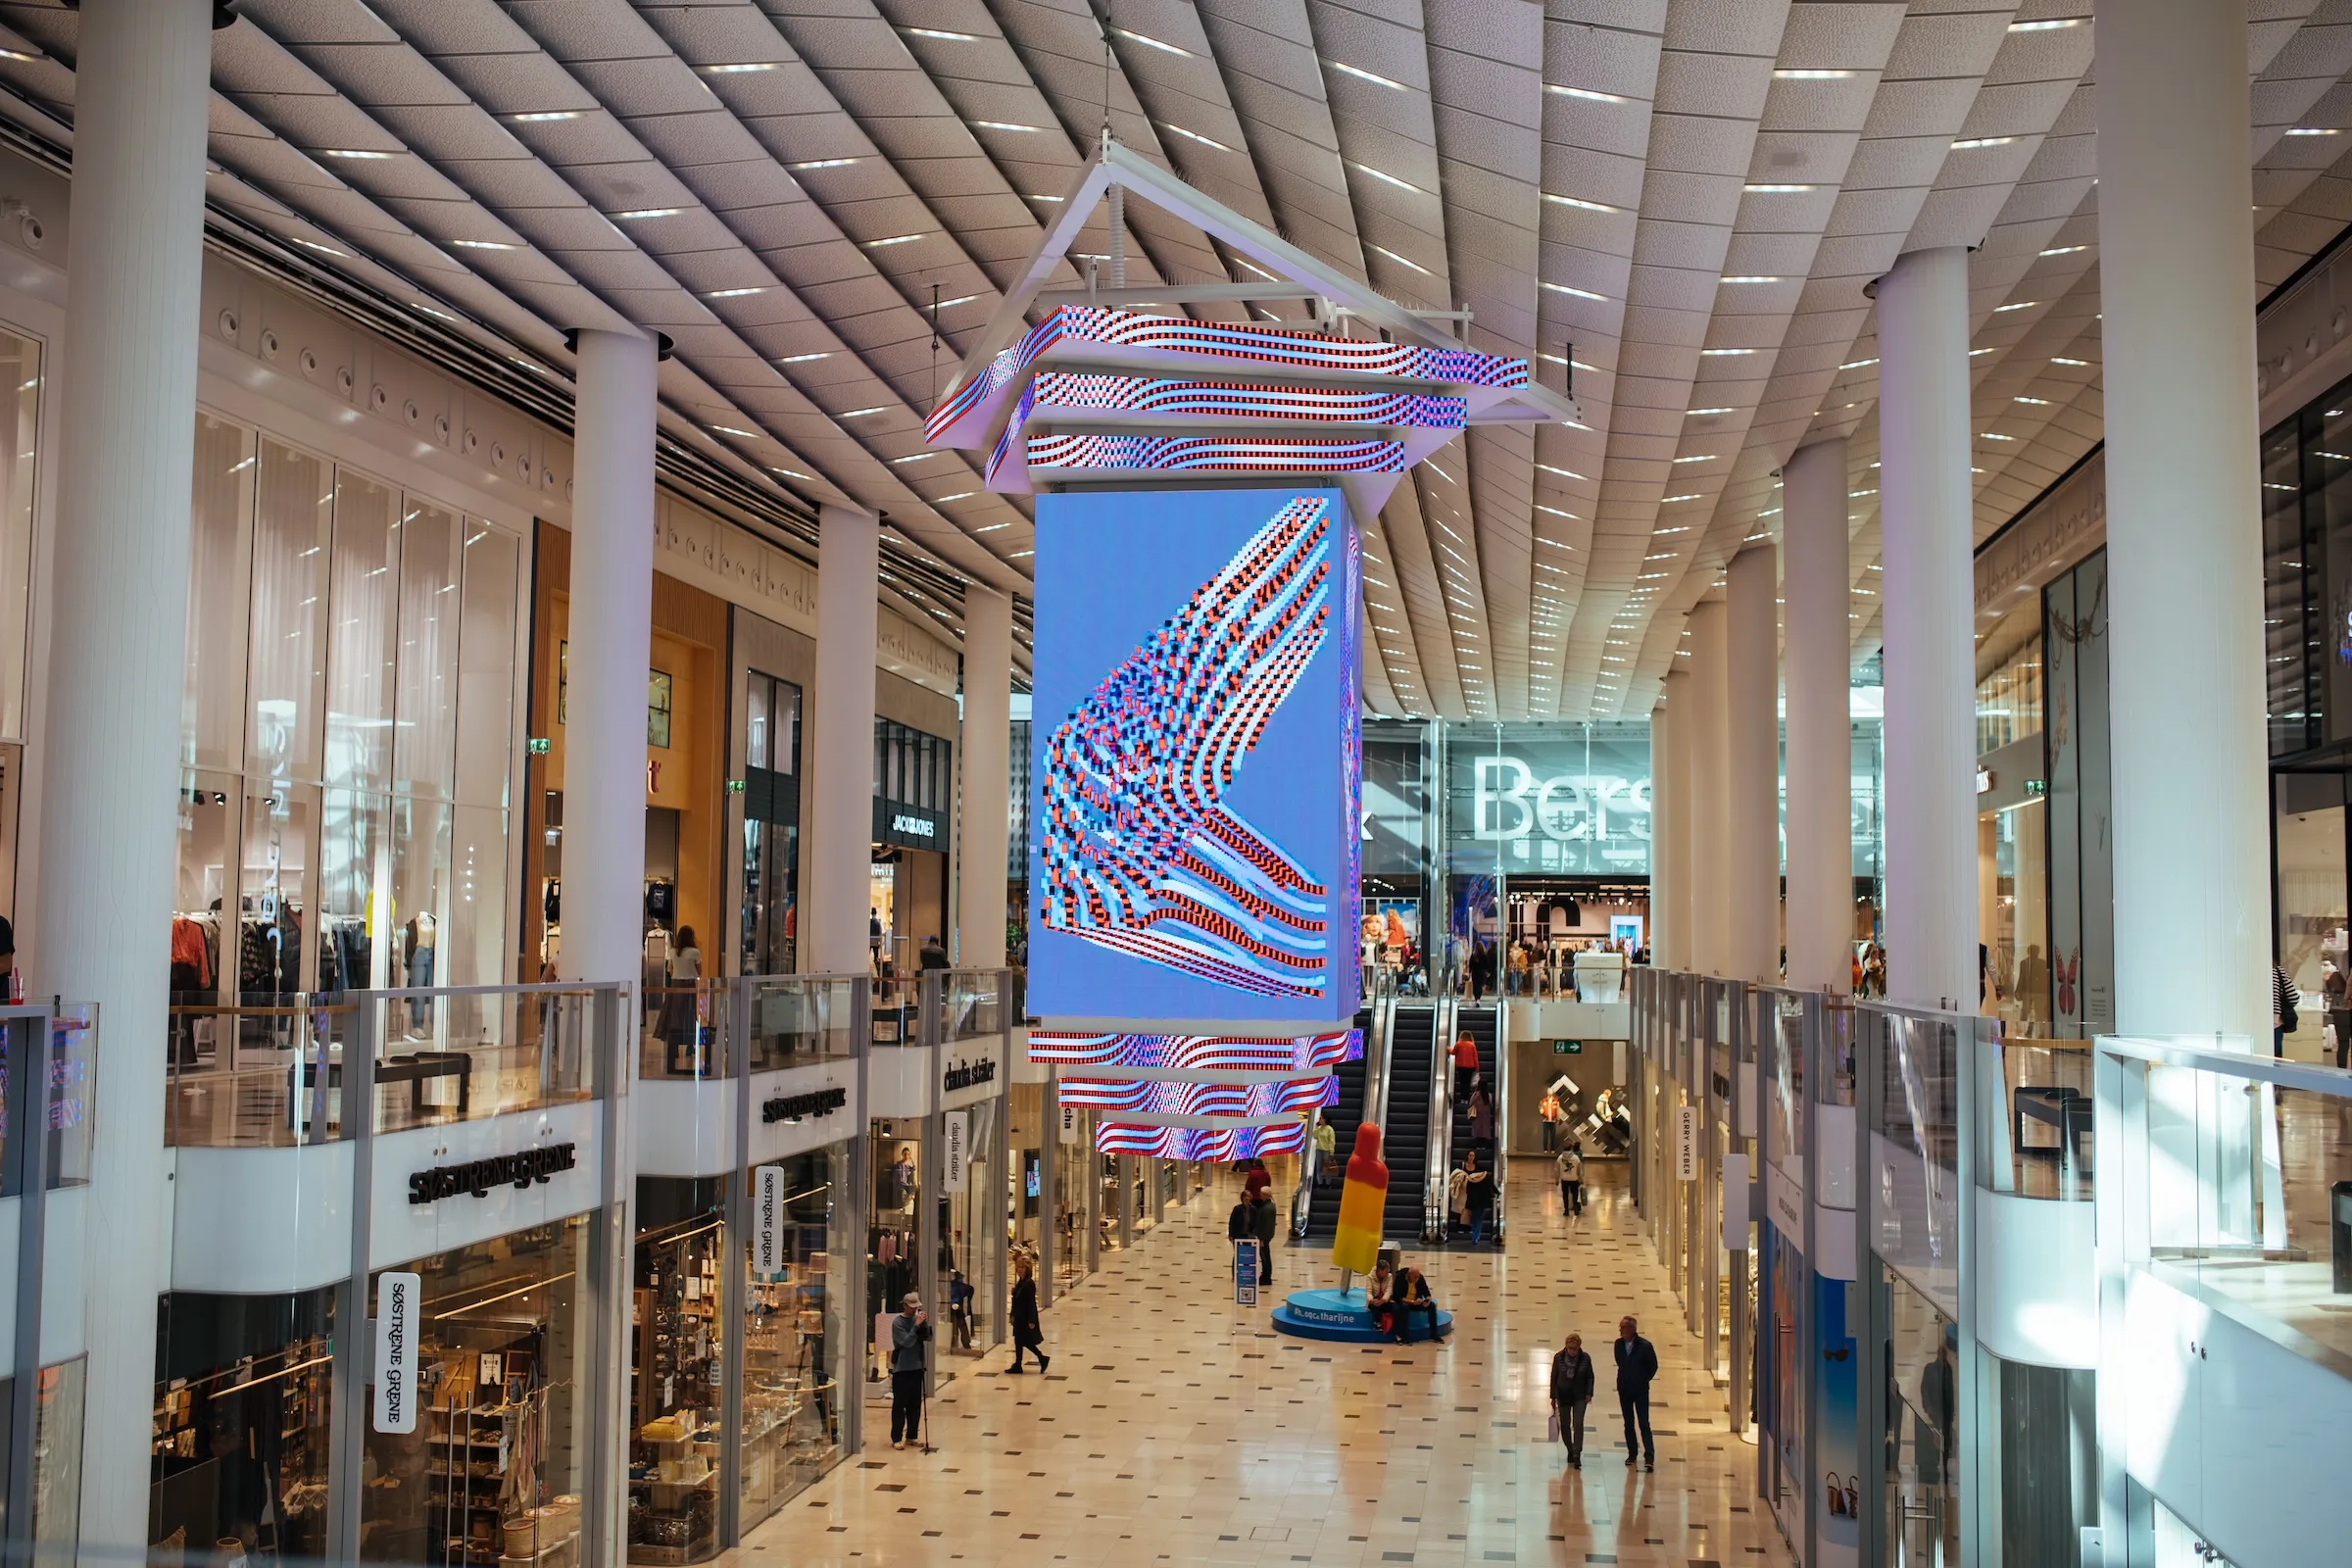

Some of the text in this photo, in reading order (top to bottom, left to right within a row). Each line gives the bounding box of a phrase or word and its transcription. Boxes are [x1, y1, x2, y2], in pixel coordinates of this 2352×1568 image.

[409, 1142, 576, 1204] SØSTRENE GRENE
[951, 1122, 961, 1182] claudia sträter
[760, 1172, 774, 1267] SØSTRENE GRENE
[386, 1282, 405, 1424] SØSTRENE GRENE
